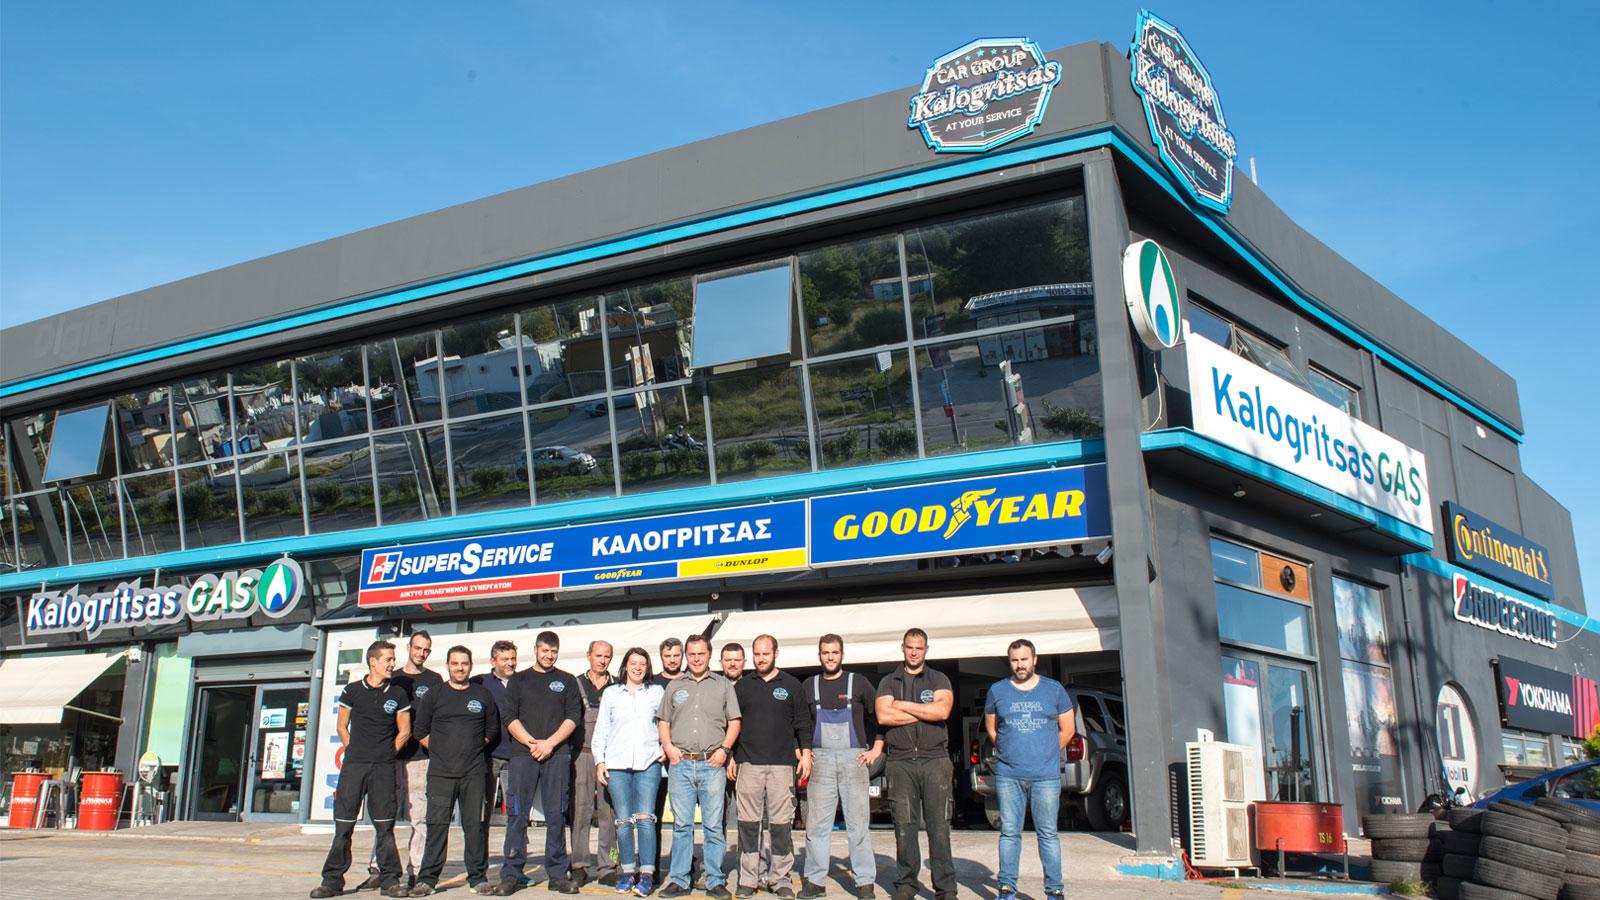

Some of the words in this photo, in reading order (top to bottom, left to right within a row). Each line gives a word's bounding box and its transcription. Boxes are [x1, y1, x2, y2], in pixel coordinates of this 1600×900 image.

[937, 65, 968, 85] CAR
[970, 50, 1026, 76] GROUP
[912, 63, 1057, 122] Kalogritsas
[945, 122, 959, 132] AT
[958, 116, 985, 129] YOUR
[985, 107, 1022, 124] SERVICE
[1164, 125, 1175, 142] AT
[1173, 135, 1193, 159] YOUR
[1191, 150, 1218, 181] SERVICE
[592, 518, 772, 557] ΚΑΛΟΓΡΙΤΣΑΣ
[1454, 514, 1539, 579] Continental
[594, 568, 643, 580] GOODYEAR
[724, 557, 769, 567] DUNLOP
[26, 588, 179, 631] Kalogritsas
[186, 576, 256, 614] GAS
[1457, 578, 1556, 643] BRIDGESTONE
[1519, 682, 1573, 716] YOKOHAMA
